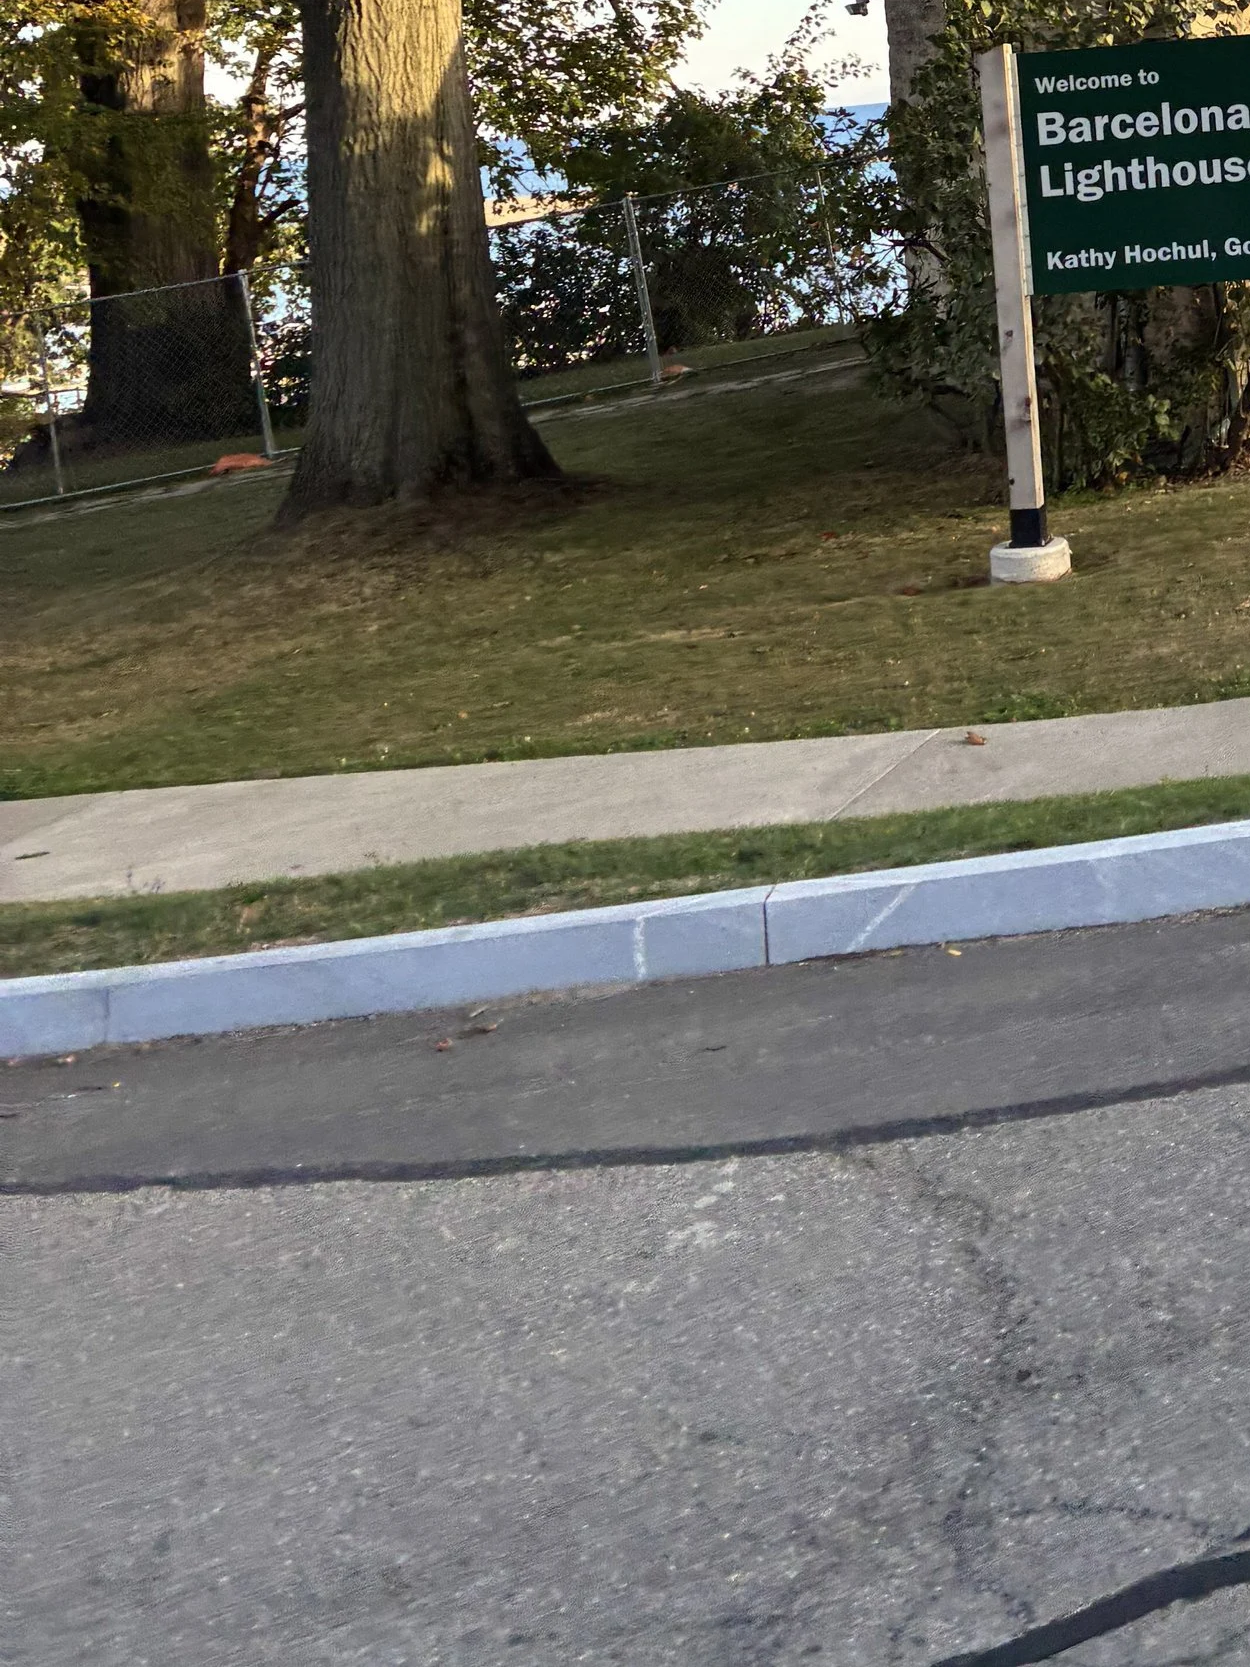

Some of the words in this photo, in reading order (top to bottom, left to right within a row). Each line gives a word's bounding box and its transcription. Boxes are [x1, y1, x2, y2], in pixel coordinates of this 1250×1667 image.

[1034, 74, 1132, 94] Welcome
[1138, 69, 1160, 86] to
[1037, 102, 1250, 146] Barcelona
[1047, 248, 1117, 270] Kathy
[1125, 240, 1218, 263] Hochul,
